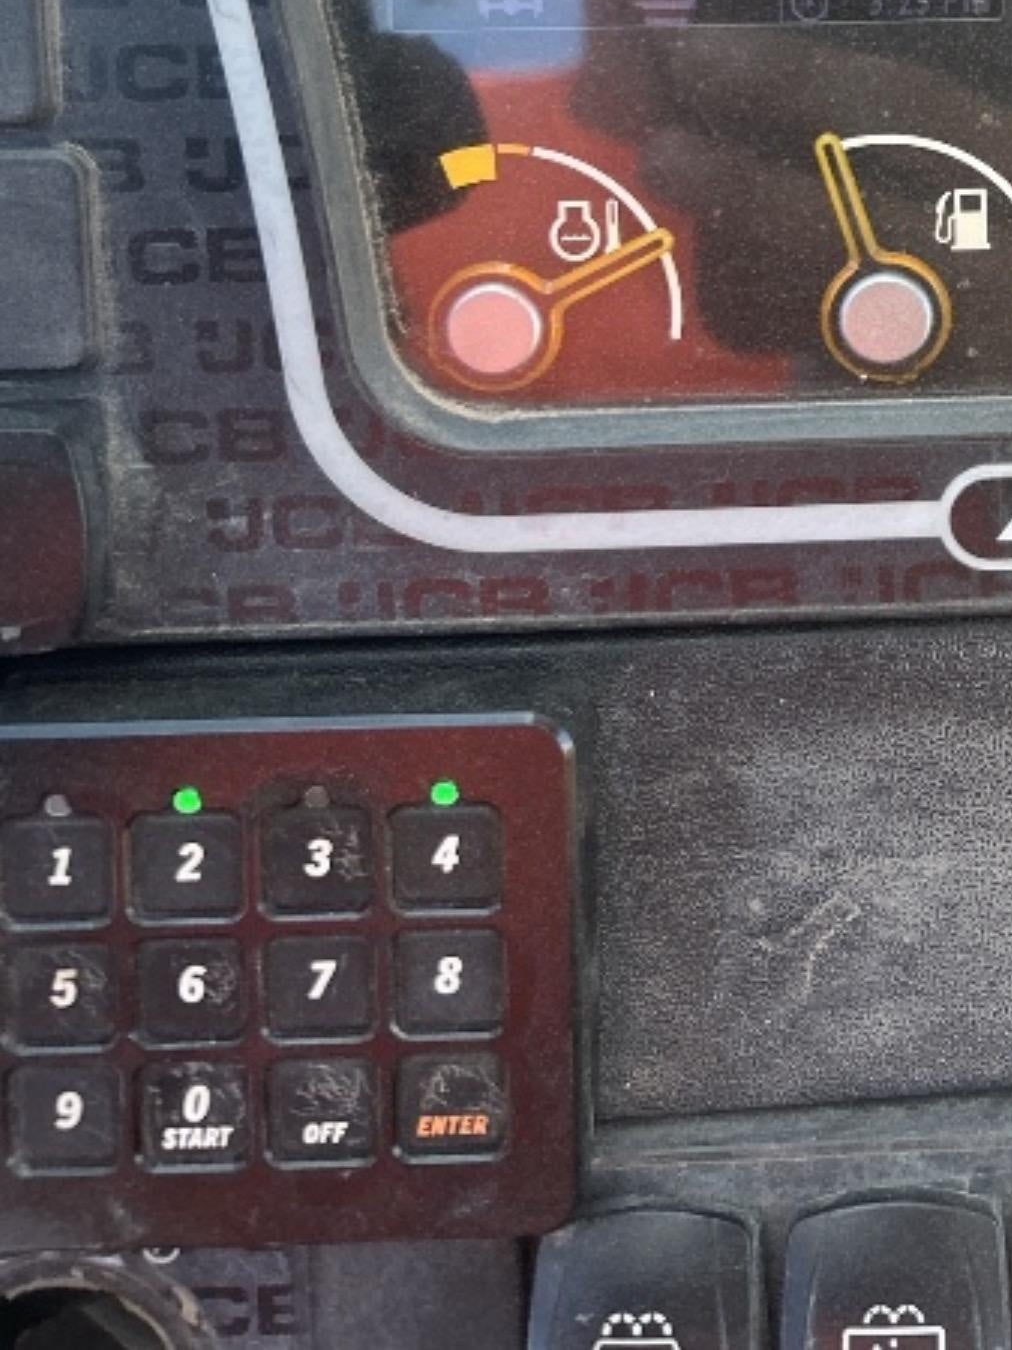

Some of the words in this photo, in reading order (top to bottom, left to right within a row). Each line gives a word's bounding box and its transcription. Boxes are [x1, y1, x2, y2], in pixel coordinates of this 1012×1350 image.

[49, 847, 72, 886] 1
[175, 842, 205, 883] 2
[304, 839, 334, 878] 3
[431, 834, 461, 874] 4
[50, 968, 78, 1007] 5
[178, 964, 207, 1004] 6
[307, 960, 337, 1000] 7
[433, 956, 463, 995] 8
[54, 1090, 84, 1130] 9
[182, 1084, 210, 1123] 0
[161, 1125, 234, 1150] START
[302, 1121, 348, 1145] OFF
[416, 1113, 489, 1139] ENTER
